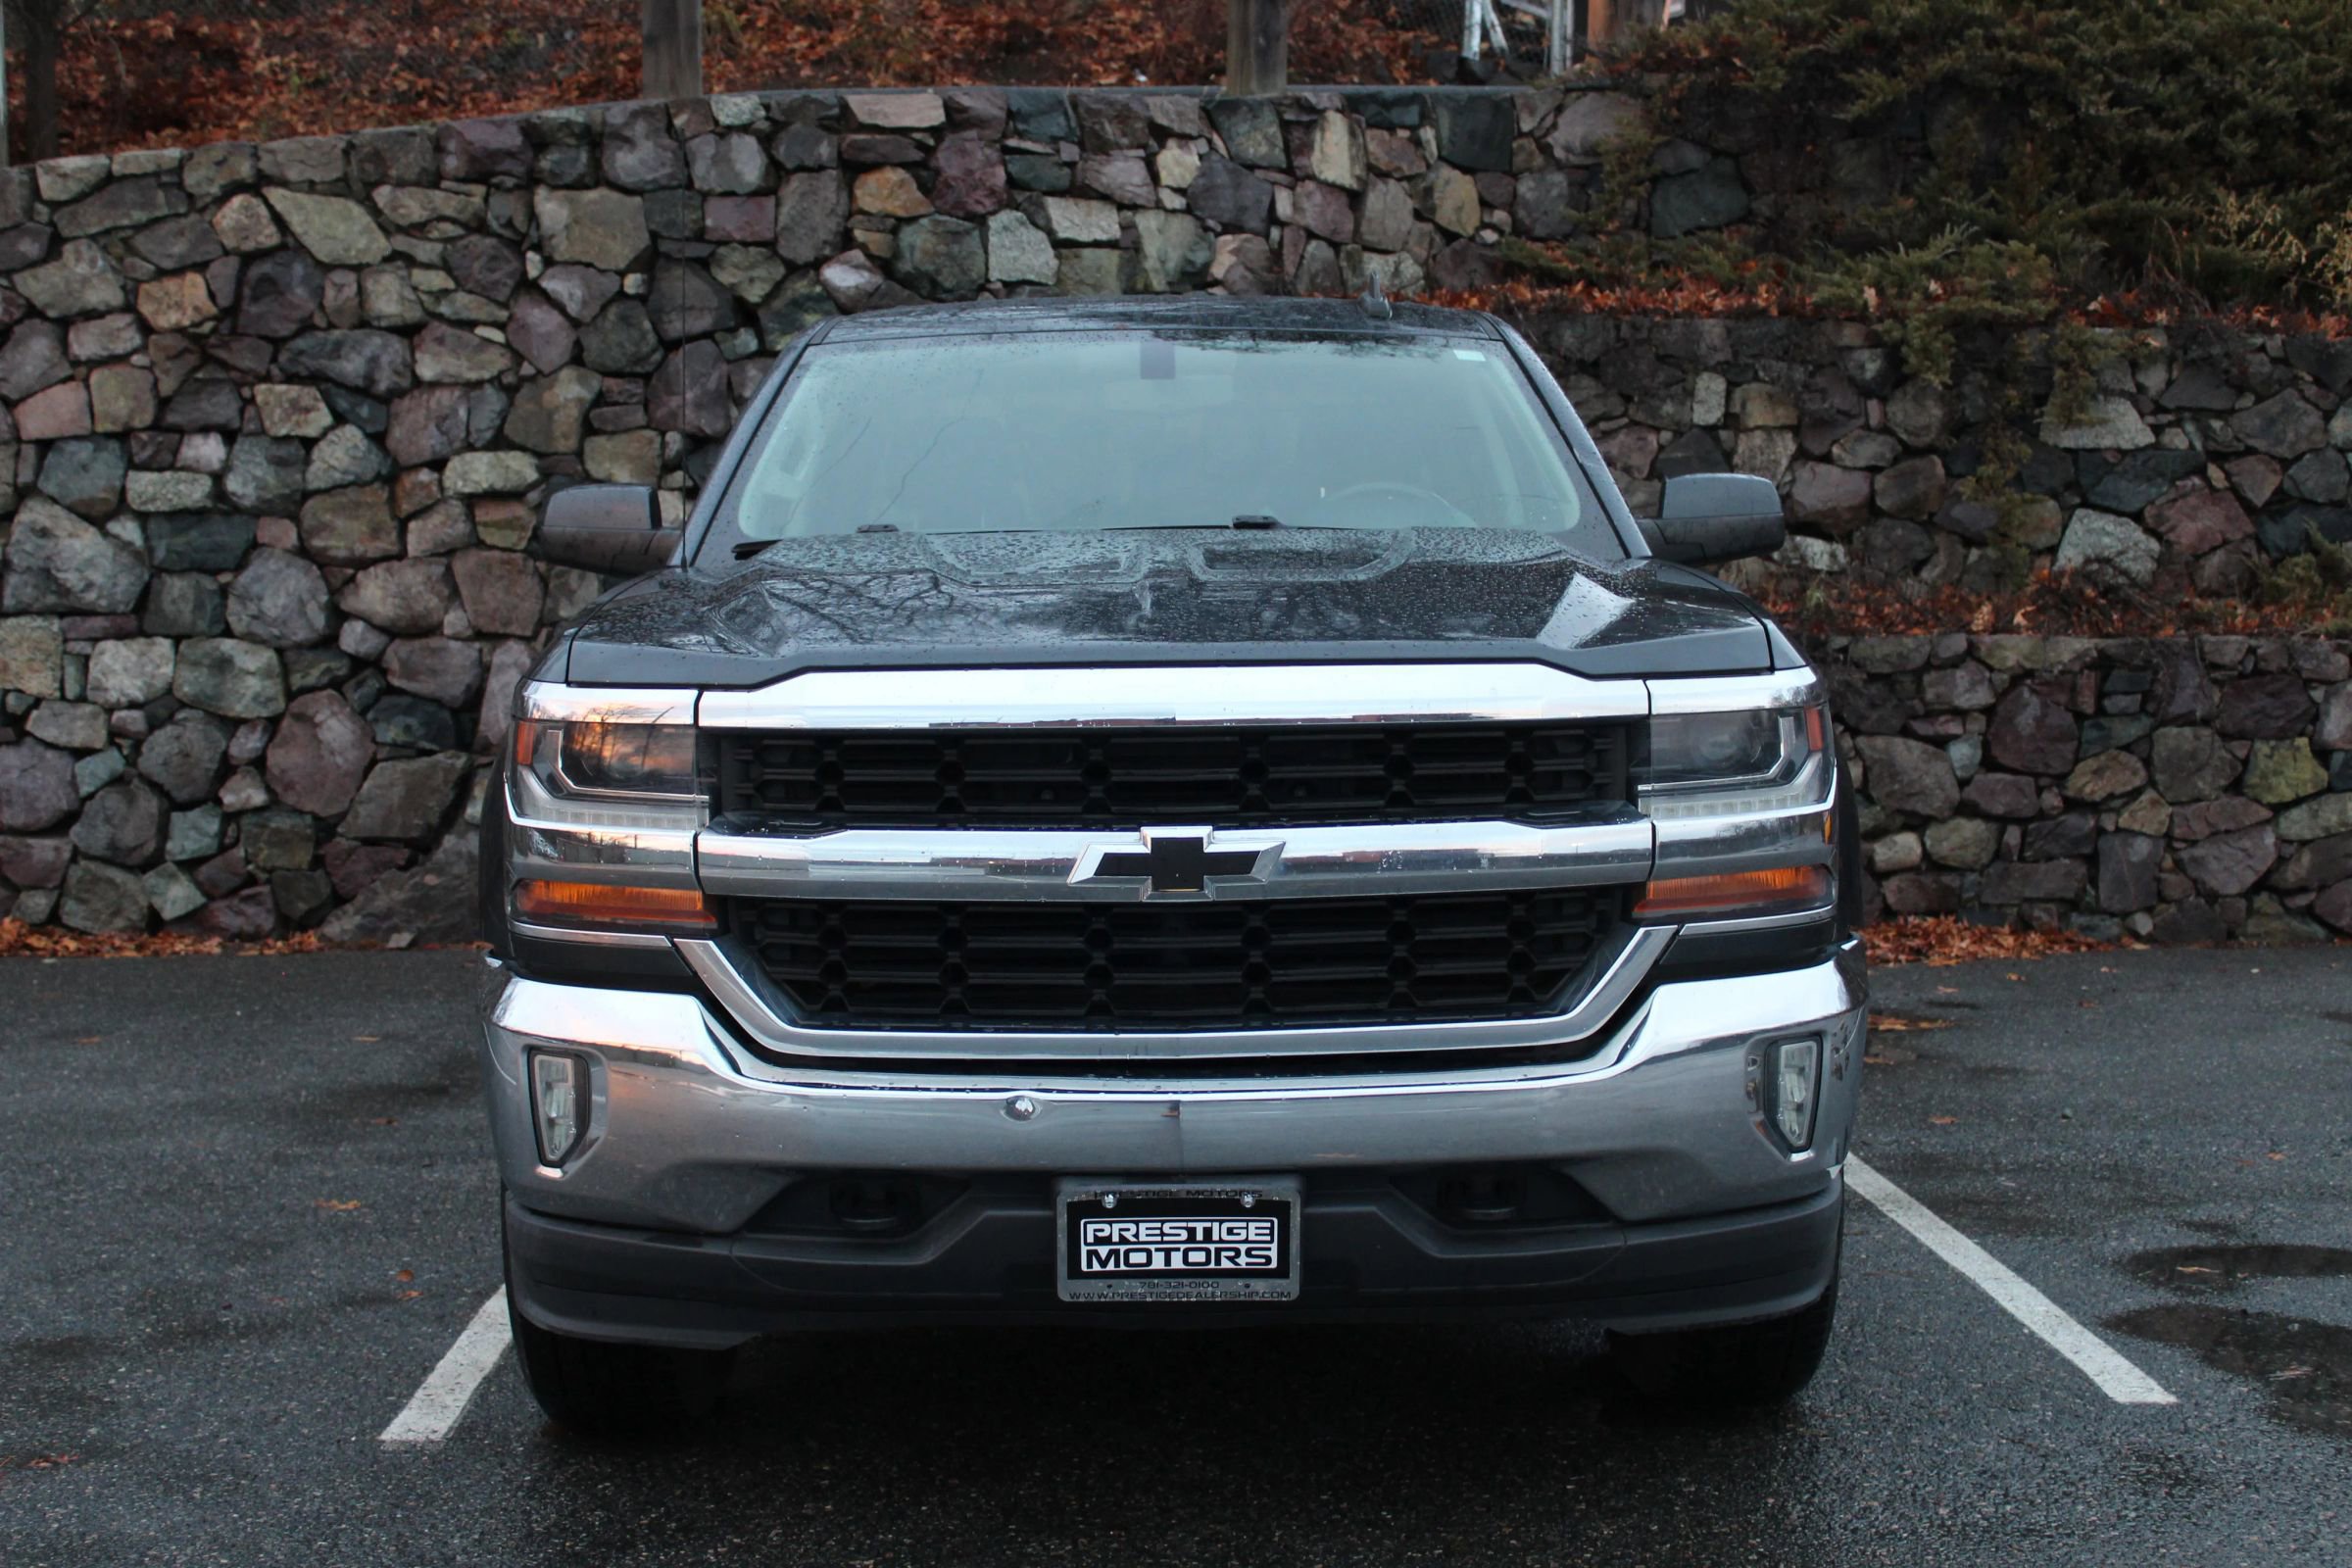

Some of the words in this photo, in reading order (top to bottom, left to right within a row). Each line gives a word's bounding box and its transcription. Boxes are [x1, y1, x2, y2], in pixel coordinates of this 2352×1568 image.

[1086, 1221, 1272, 1244] PRESTIGE
[1086, 1246, 1273, 1270] MOTORS
[1139, 1280, 1220, 1290] 781-321-0100
[1068, 1291, 1292, 1300] WWW.PRESTIGEDEALERSHIP.COM
